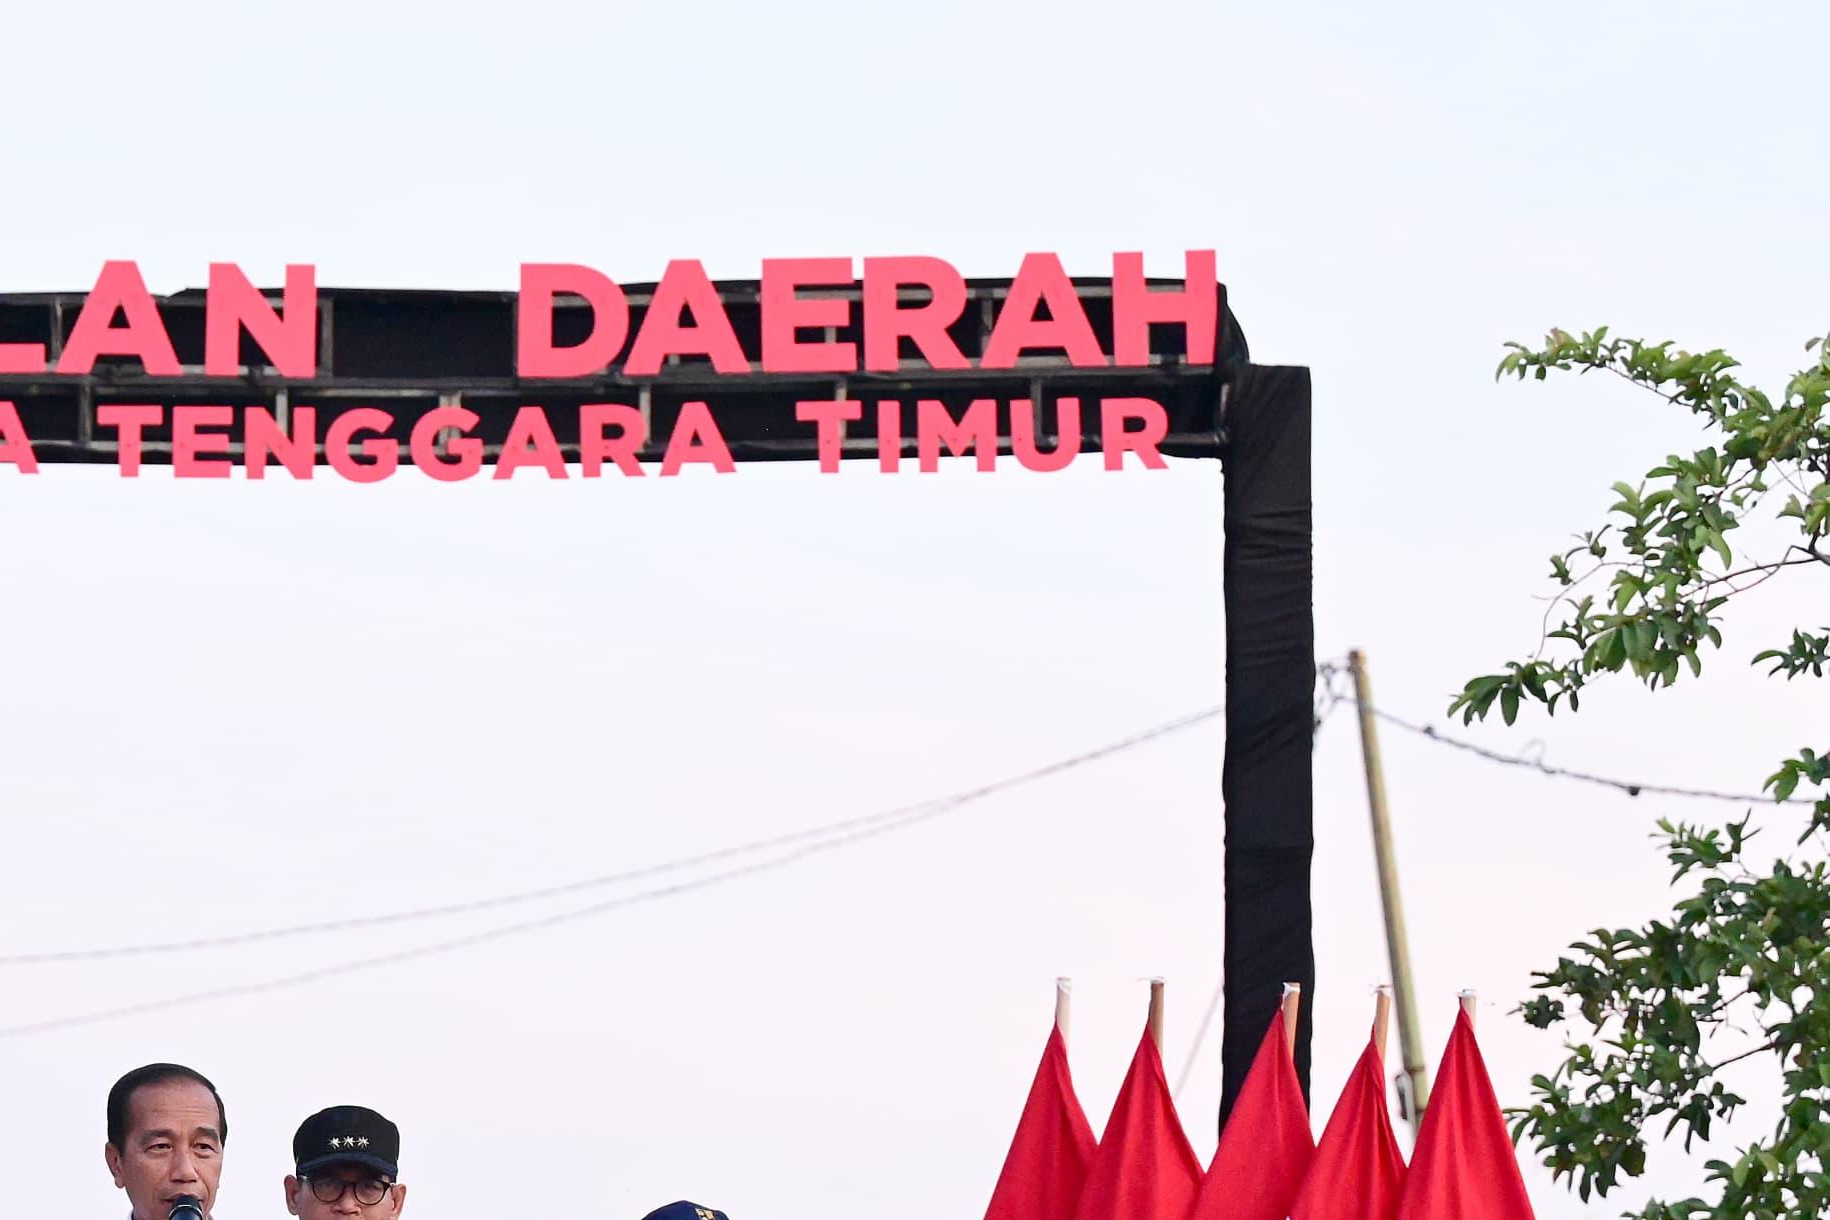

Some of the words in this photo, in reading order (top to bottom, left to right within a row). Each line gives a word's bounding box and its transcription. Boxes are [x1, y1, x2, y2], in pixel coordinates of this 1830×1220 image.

[516, 250, 1219, 379] DAERAH
[96, 401, 735, 483] TENGGARA
[795, 397, 1169, 473] TIMUR
